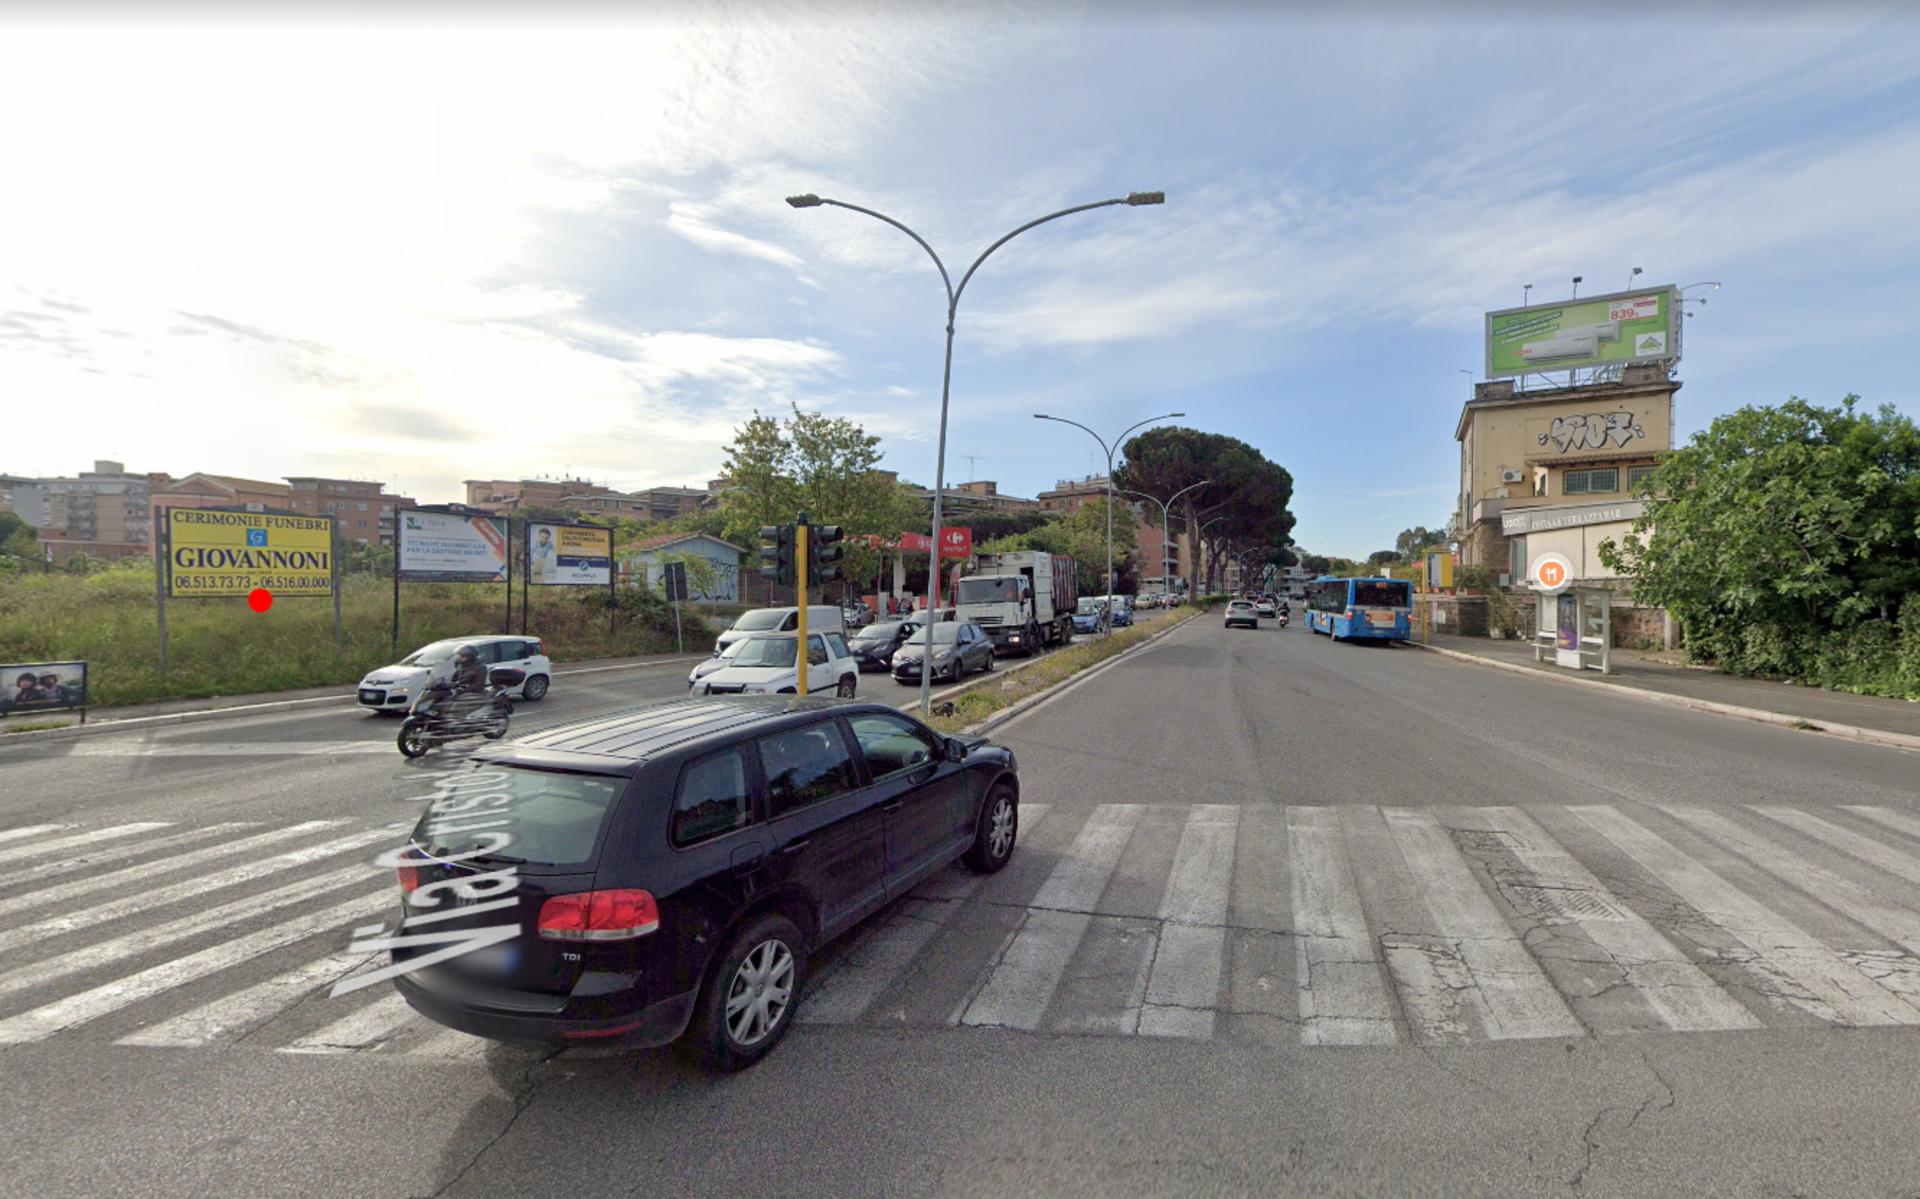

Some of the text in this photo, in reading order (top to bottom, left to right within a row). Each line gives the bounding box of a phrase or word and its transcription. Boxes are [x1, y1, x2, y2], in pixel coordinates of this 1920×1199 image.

[173, 511, 329, 531] CERIMONIE FUNEBRI
[175, 547, 328, 570] GIOVANNONI
[562, 952, 581, 961] TDI
